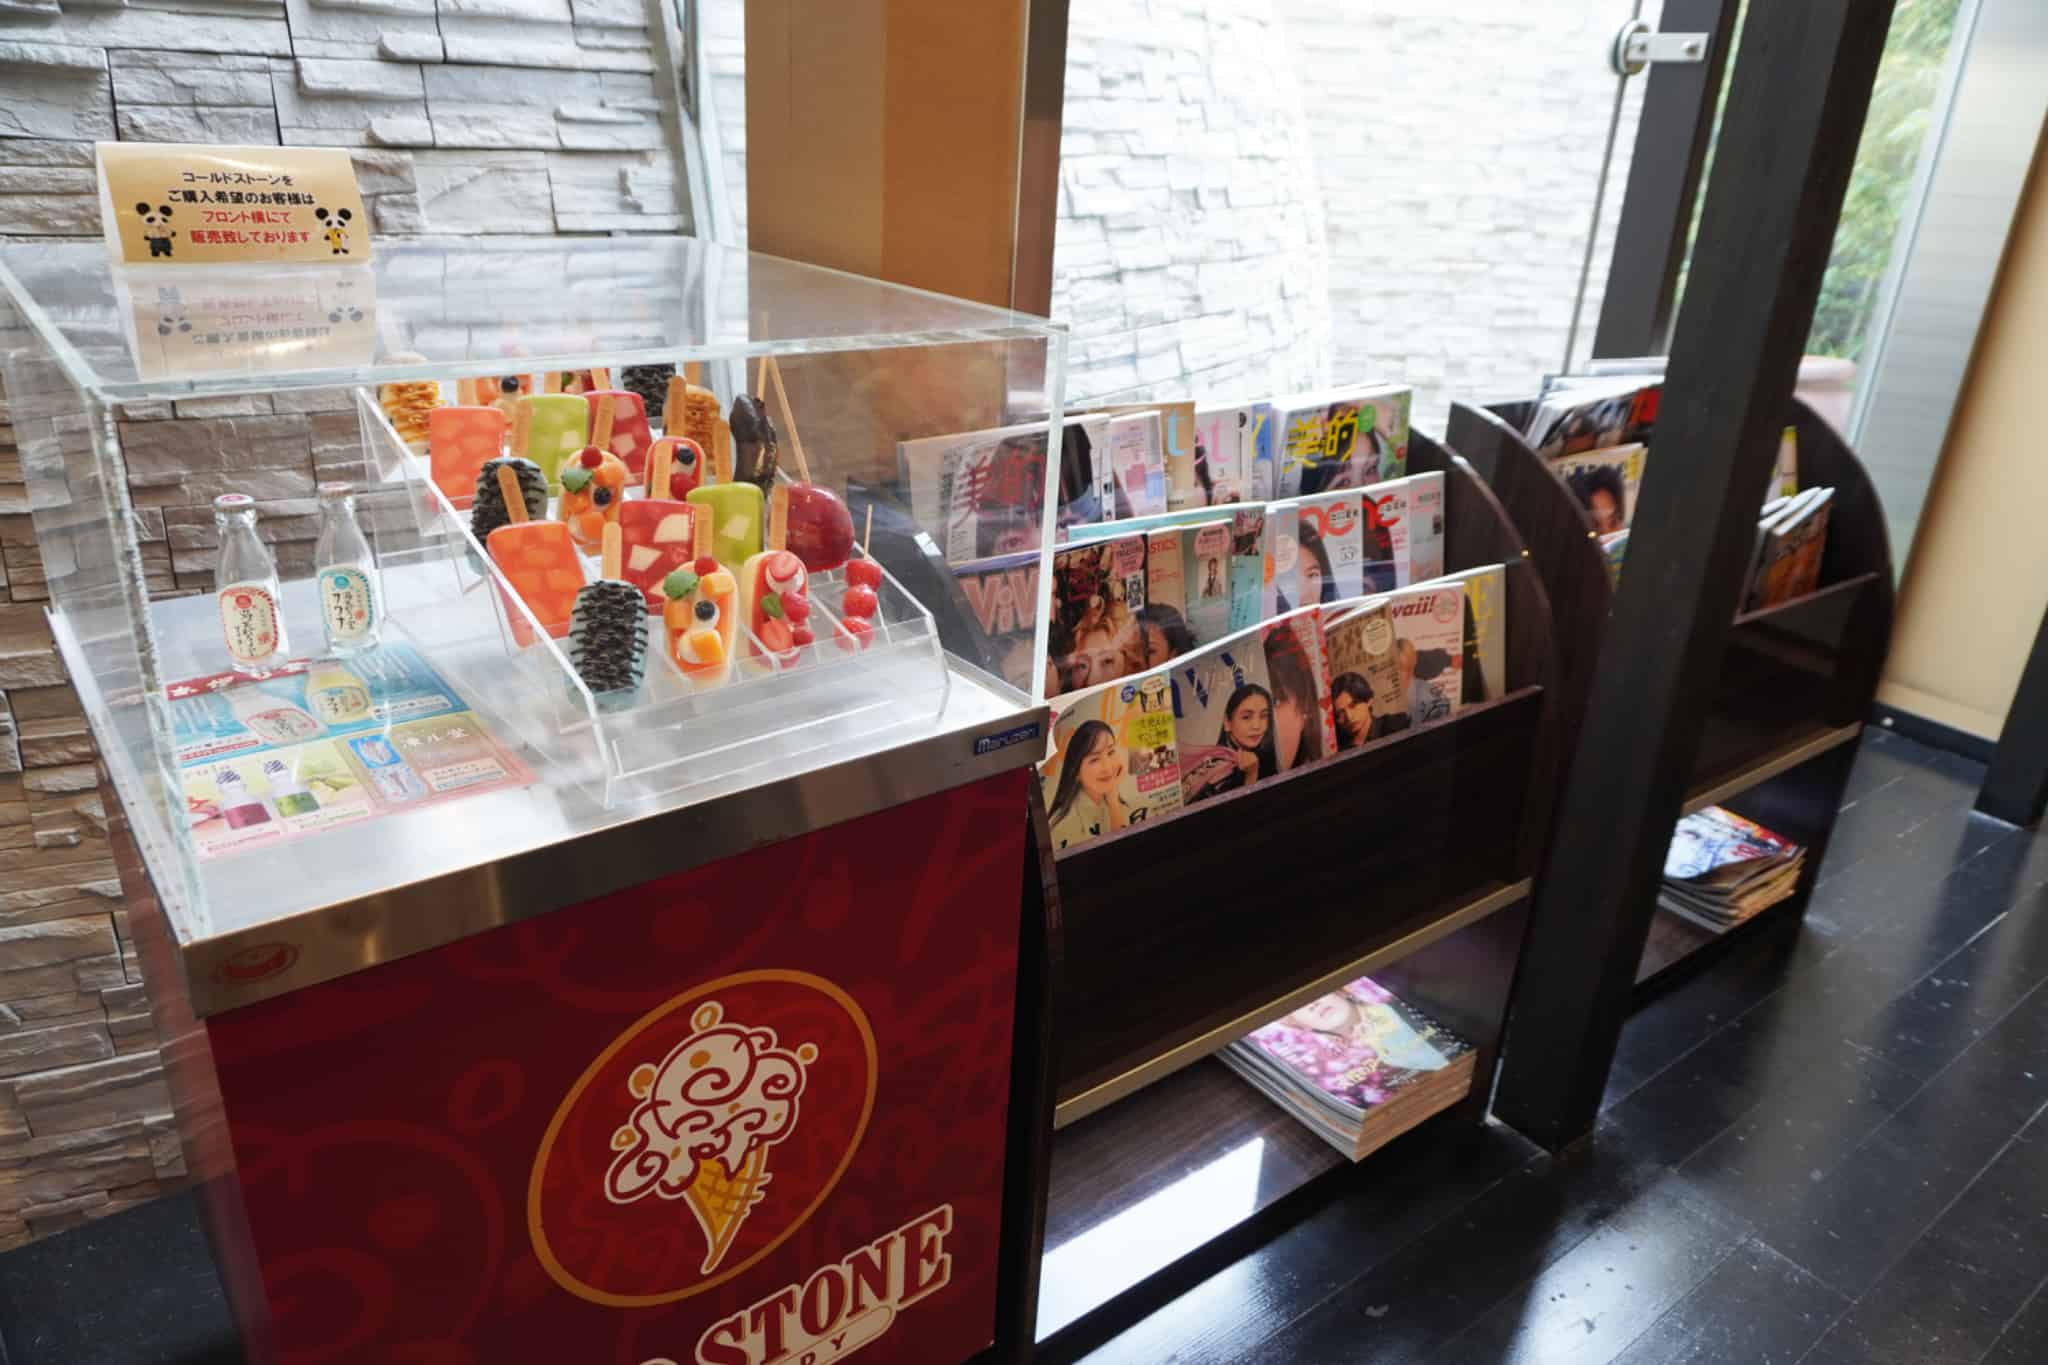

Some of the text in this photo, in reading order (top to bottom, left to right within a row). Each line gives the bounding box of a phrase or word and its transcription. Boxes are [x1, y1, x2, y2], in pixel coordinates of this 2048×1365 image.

[182, 172, 294, 186] コールドストーンを
[168, 190, 315, 204] ご購入希望のお客様は
[202, 210, 291, 223] フロント横にて
[190, 230, 310, 244] 販売致しております
[1282, 407, 1359, 474] 美的
[698, 1206, 952, 1365] STONE
